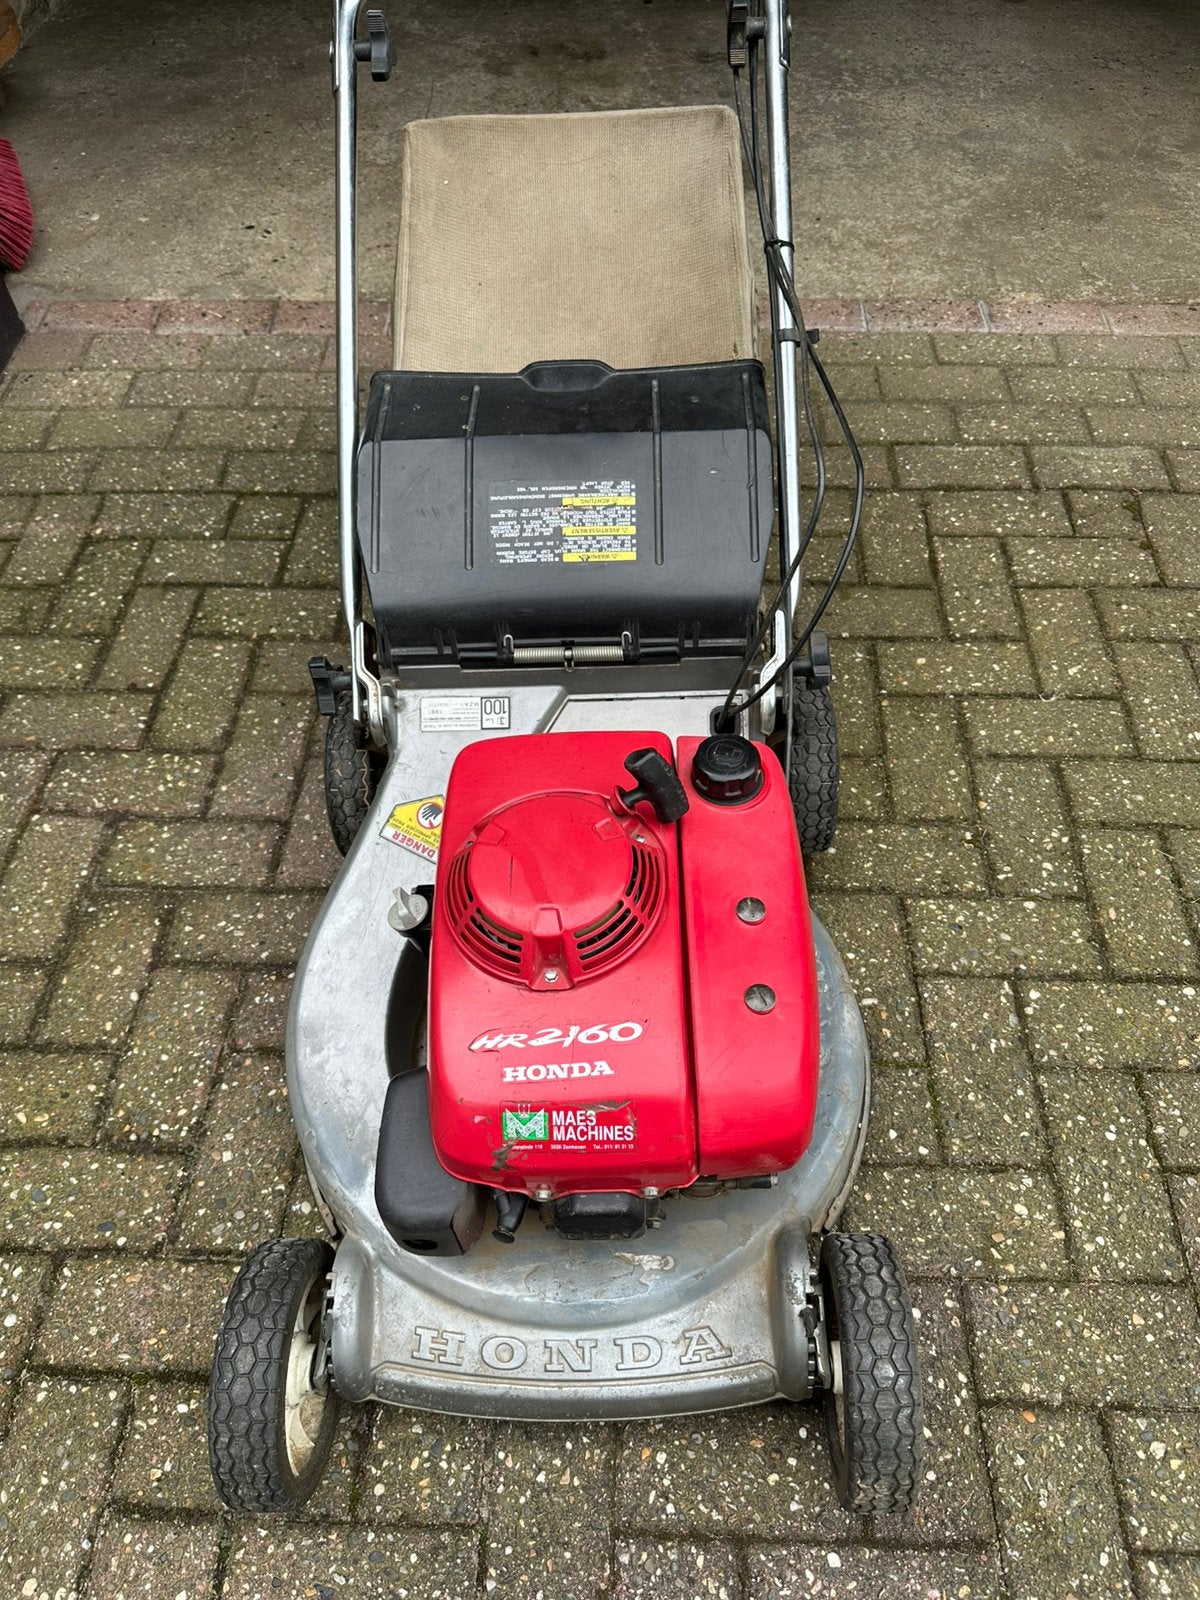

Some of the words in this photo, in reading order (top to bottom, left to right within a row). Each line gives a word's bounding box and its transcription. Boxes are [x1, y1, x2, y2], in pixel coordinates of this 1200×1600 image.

[484, 699, 507, 715] 100
[392, 831, 436, 858] DANGER
[470, 1022, 643, 1048] HR2160
[502, 1060, 615, 1082] HONDA
[552, 1110, 596, 1126] MAES
[552, 1126, 634, 1141] MACHINES
[411, 1325, 733, 1373] HONDA
